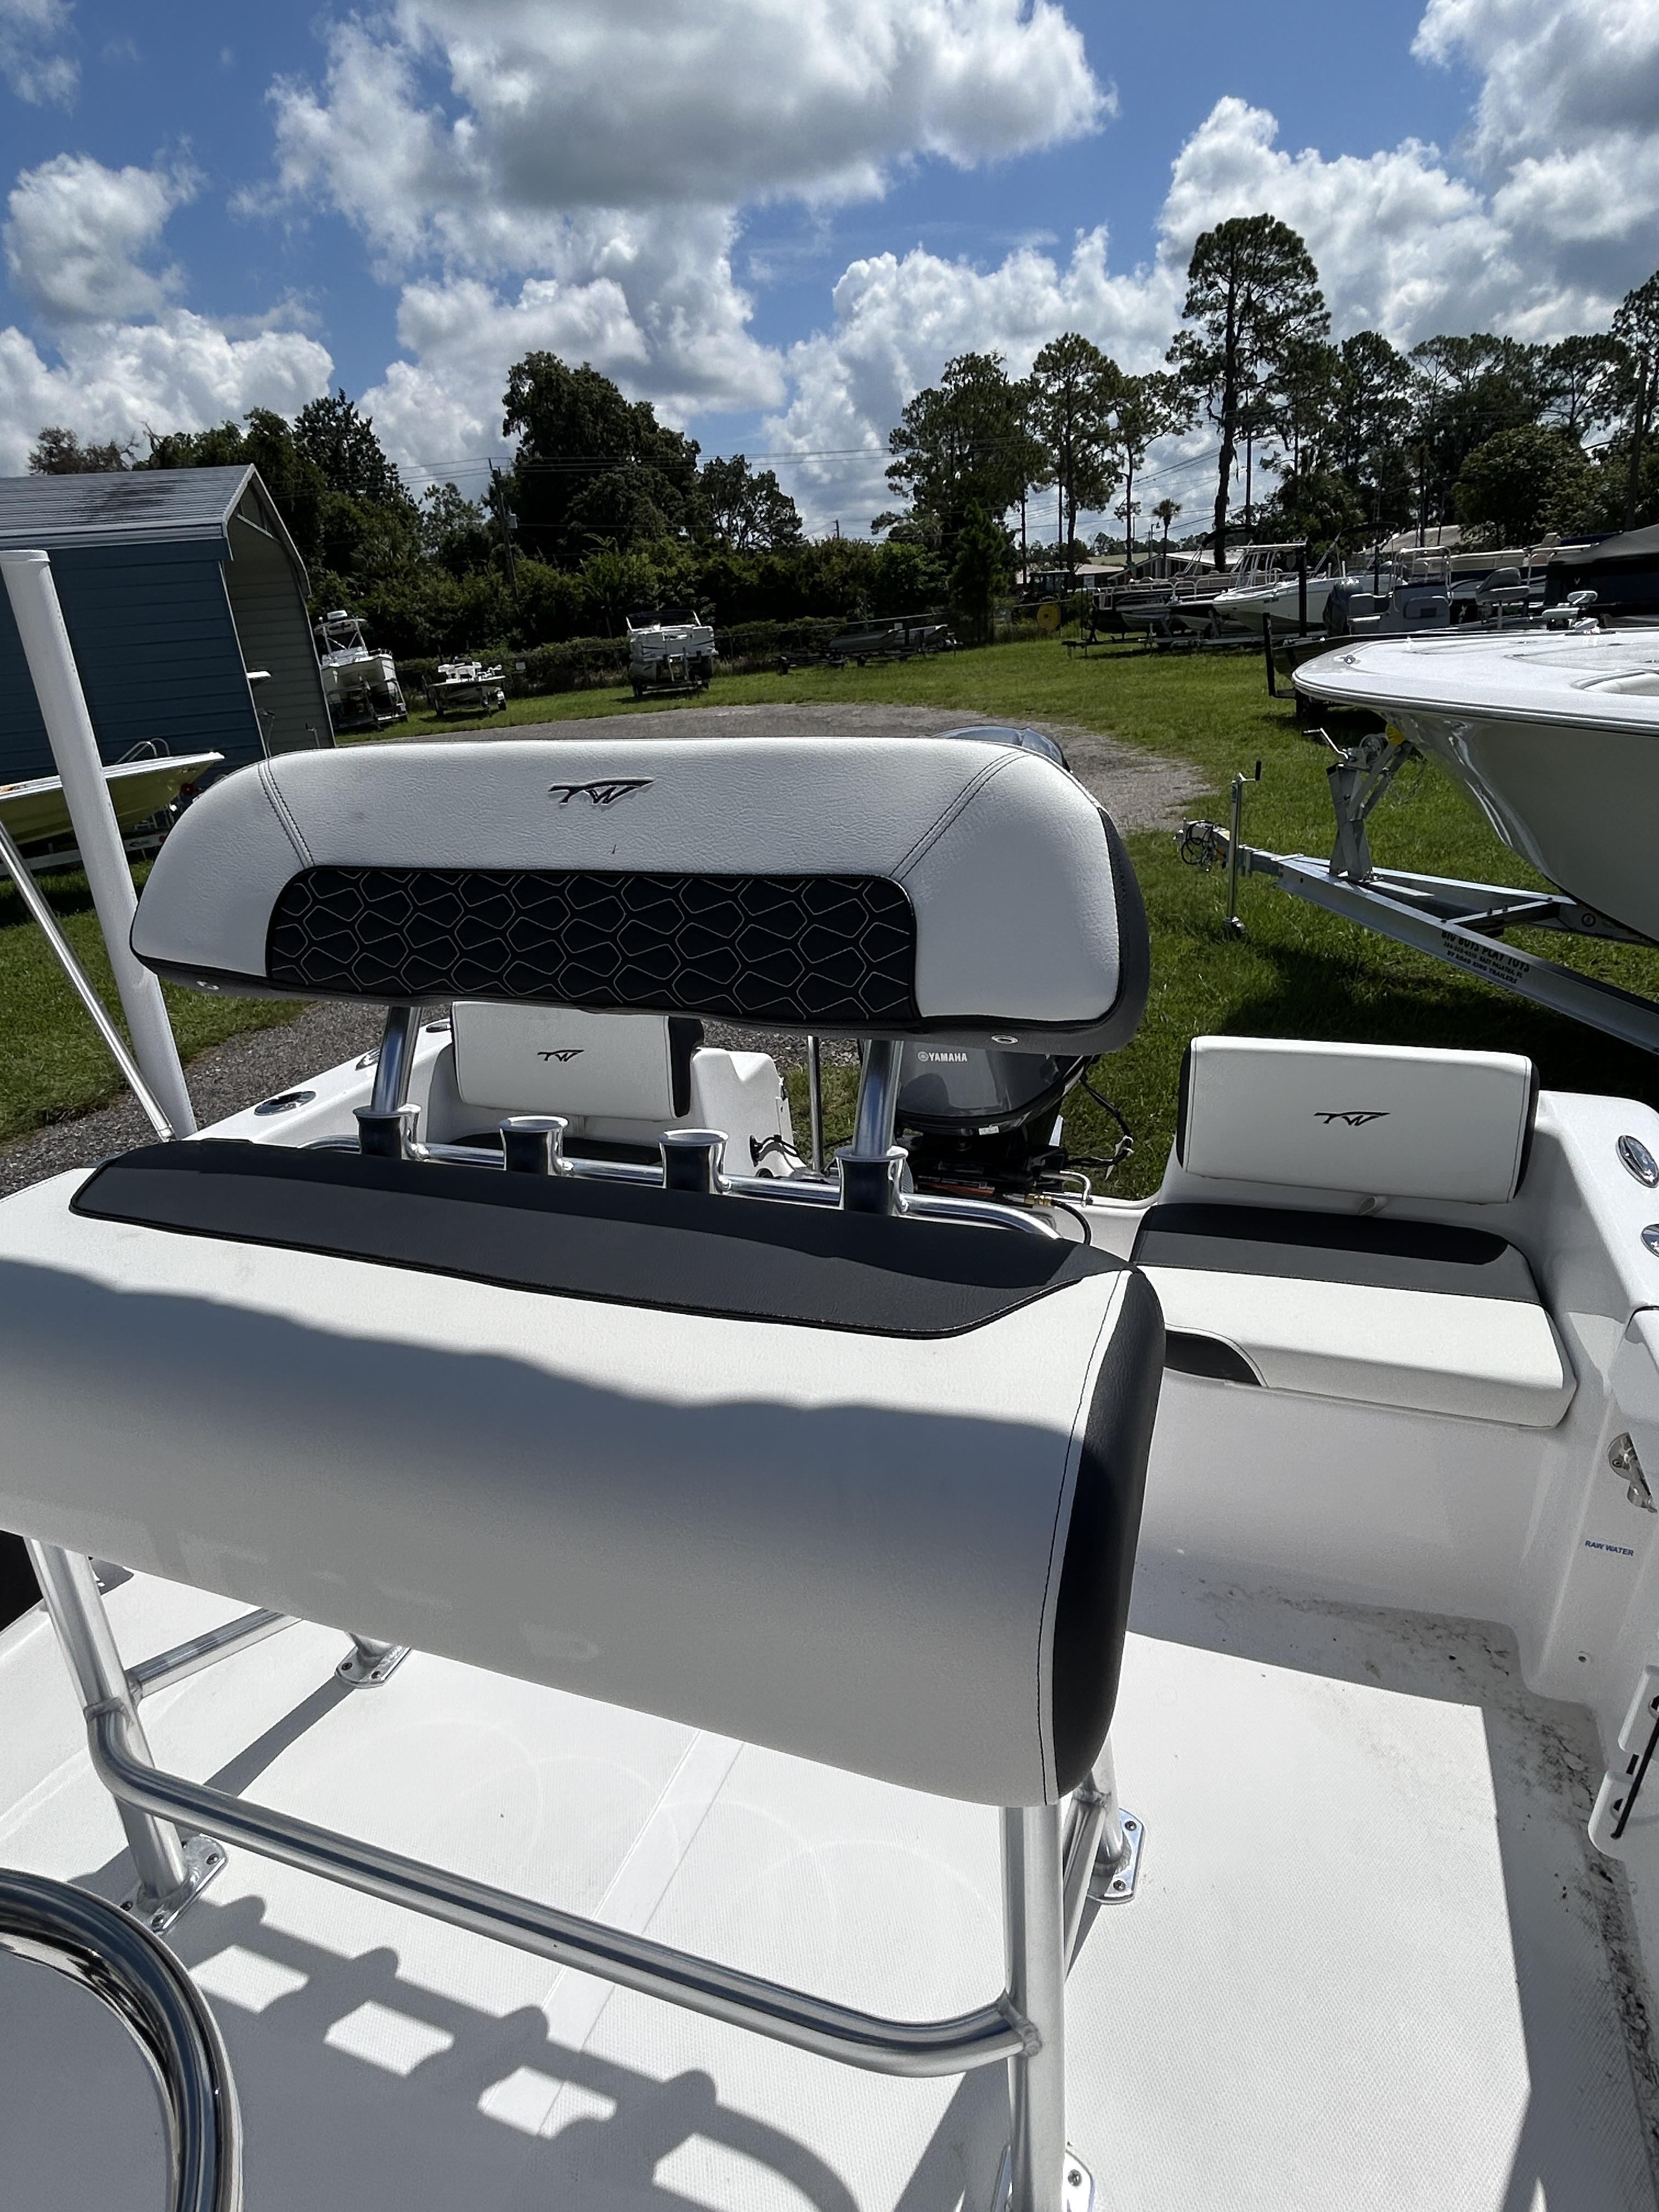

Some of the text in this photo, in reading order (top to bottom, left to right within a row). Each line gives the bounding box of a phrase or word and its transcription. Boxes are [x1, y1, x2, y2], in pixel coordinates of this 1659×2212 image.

[1455, 954, 1471, 964] ROAD
[1472, 961, 1487, 971] KING
[1489, 967, 1518, 984] TRAILERS
[928, 1052, 968, 1062] YAMAHA
[1585, 1539, 1634, 1556] RAW WATER
